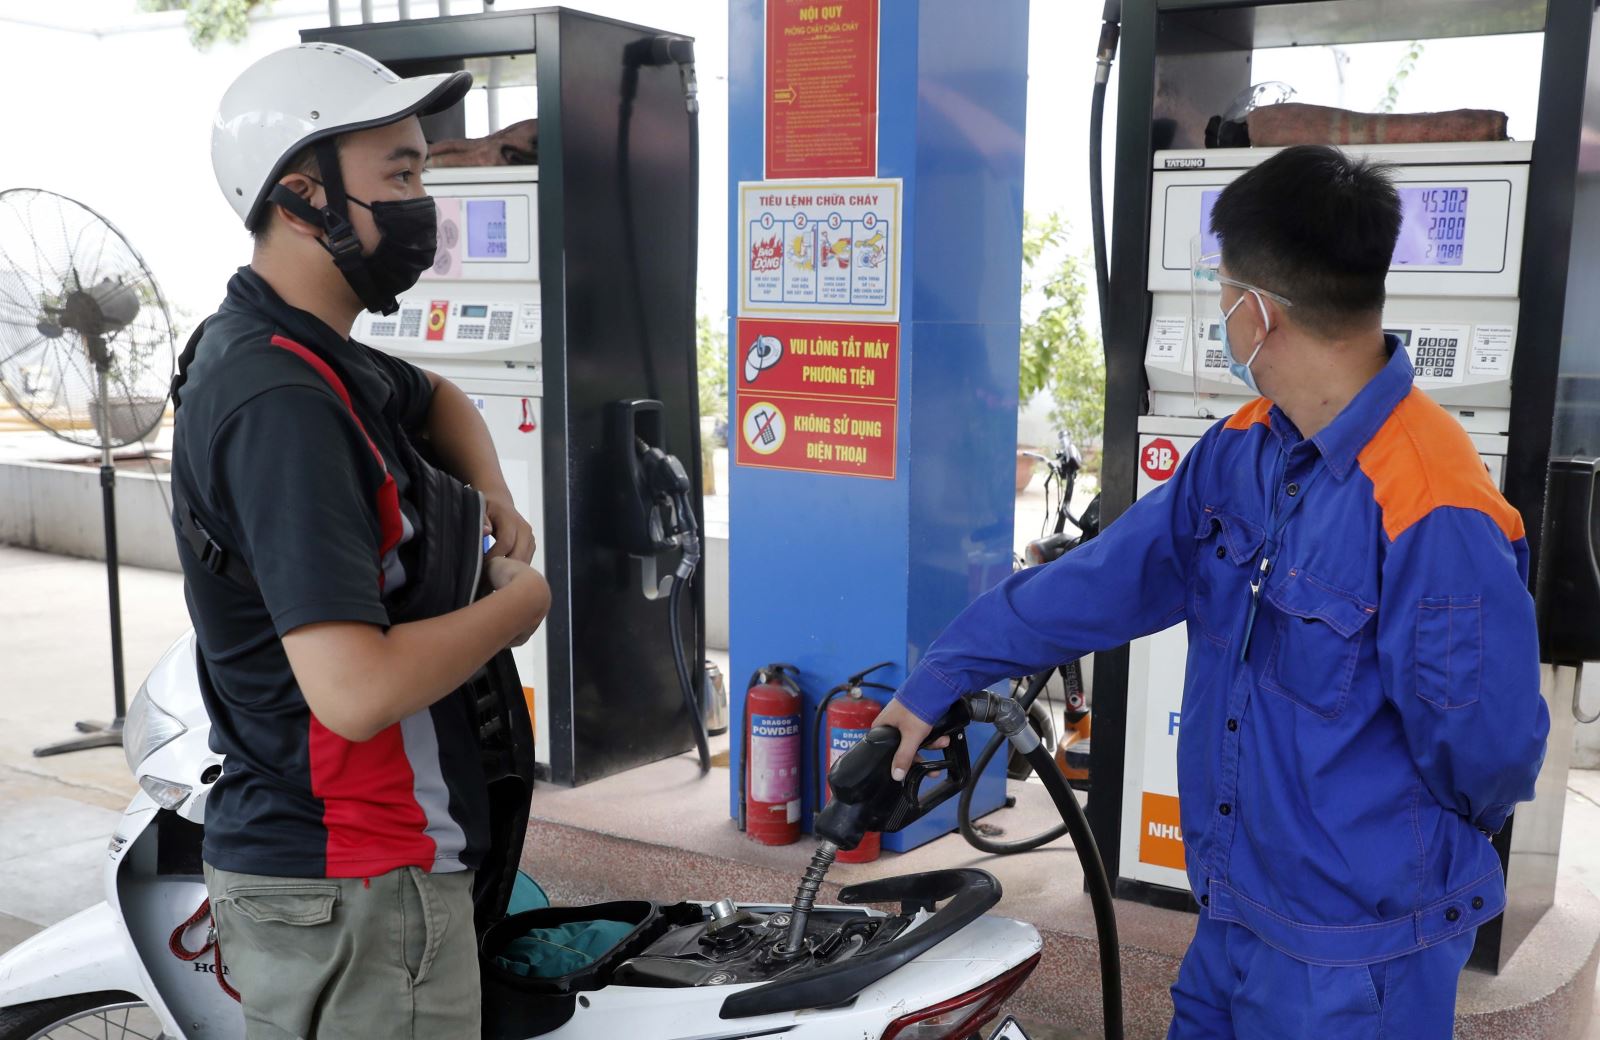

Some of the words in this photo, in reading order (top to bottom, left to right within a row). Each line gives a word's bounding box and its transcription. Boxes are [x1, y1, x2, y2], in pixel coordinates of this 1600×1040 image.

[800, 6, 818, 22] NỘI
[822, 6, 842, 20] QUY
[784, 26, 806, 36] PHÒNG
[806, 24, 823, 34] CHÁY
[842, 21, 859, 32] CHÁY
[1166, 159, 1204, 167] TATSUNO
[760, 194, 782, 206] TIÊU
[786, 194, 812, 208] LỆNH
[816, 194, 846, 206] CHỮA
[849, 194, 878, 206] CHÁY
[1422, 190, 1468, 212] 45302
[832, 216, 838, 226] 3
[866, 216, 873, 226] 4
[754, 257, 779, 269] ĐỘNG
[790, 338, 807, 355] VUI
[810, 336, 839, 356] LÒNG
[842, 336, 860, 358] TẮT
[864, 340, 889, 359] MÁY
[802, 366, 847, 384] PHƯƠNG
[850, 366, 875, 388] TIỆN
[794, 412, 831, 434] KHÔNG
[834, 414, 849, 435] SỬ
[851, 420, 882, 440] DỤNG
[807, 441, 832, 463] ĐIỆN
[835, 445, 867, 466] THOẠI
[1146, 447, 1172, 470] 3B
[753, 724, 799, 736] POWDER
[833, 738, 858, 749] POW
[194, 962, 230, 975] HON
